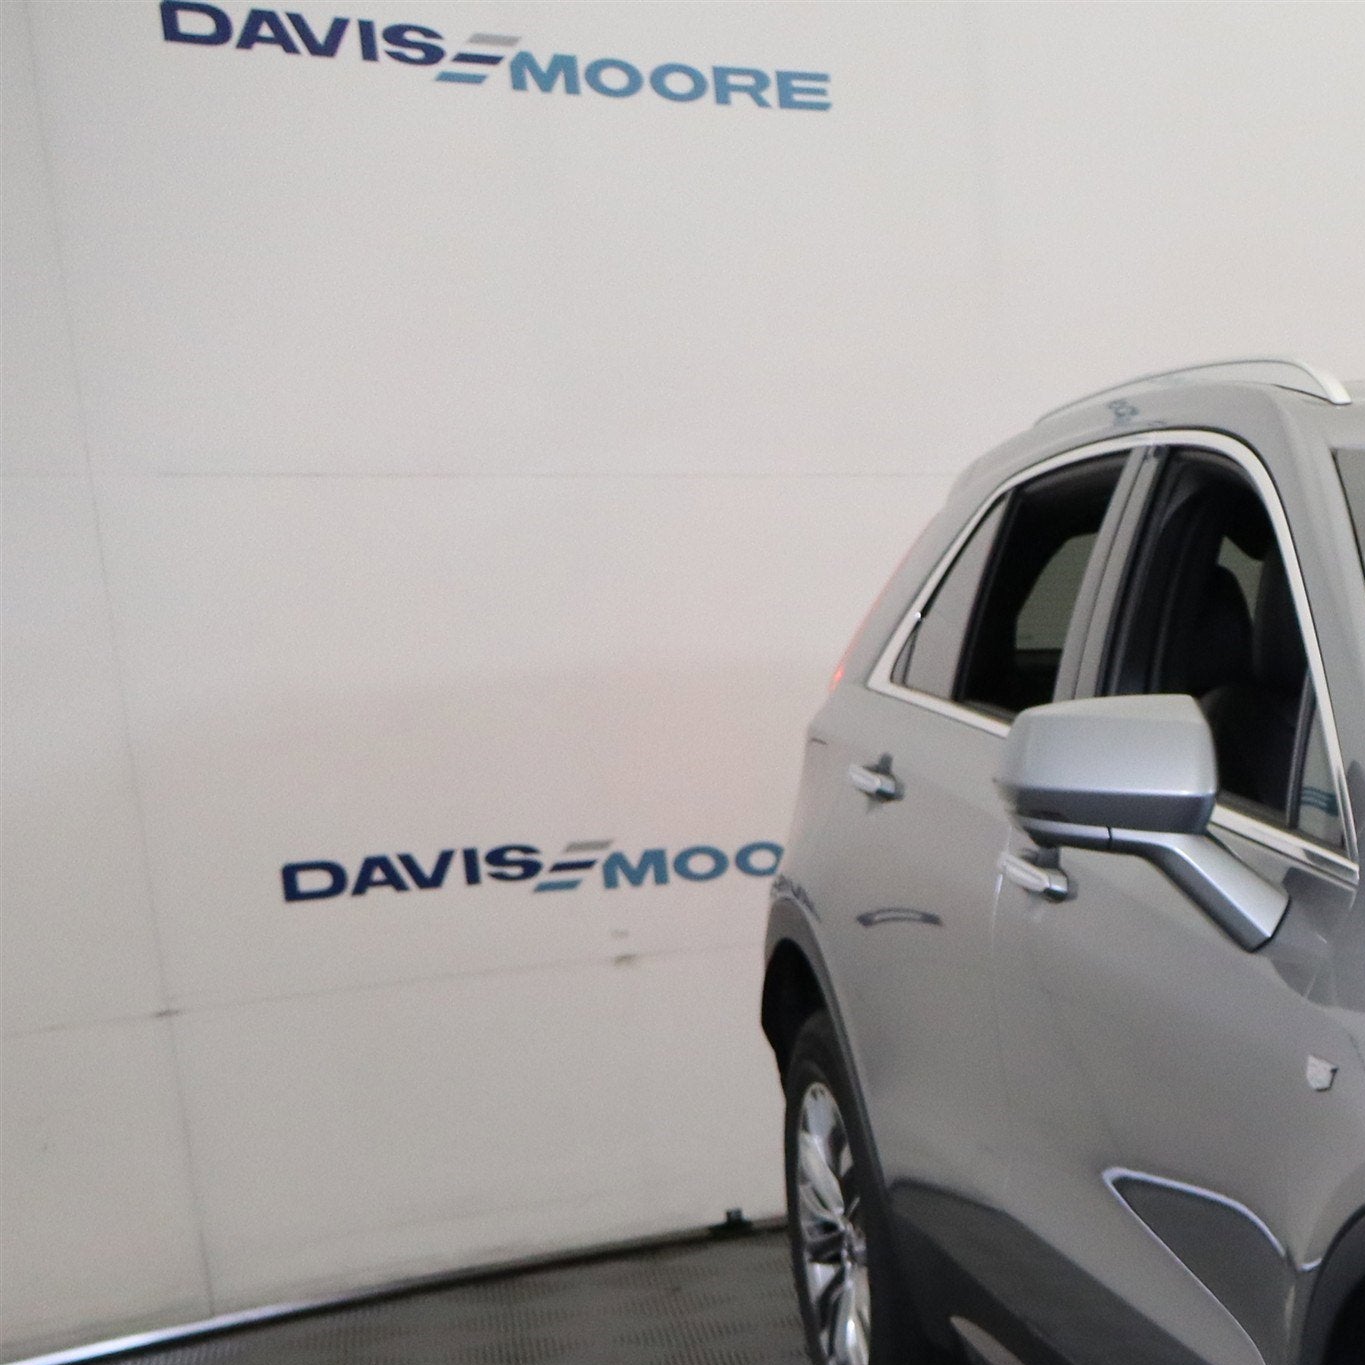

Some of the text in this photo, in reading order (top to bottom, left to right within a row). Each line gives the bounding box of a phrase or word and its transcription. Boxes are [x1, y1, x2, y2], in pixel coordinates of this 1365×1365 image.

[160, 0, 833, 112] DAVIS MOORE
[281, 844, 544, 903] DAVIS
